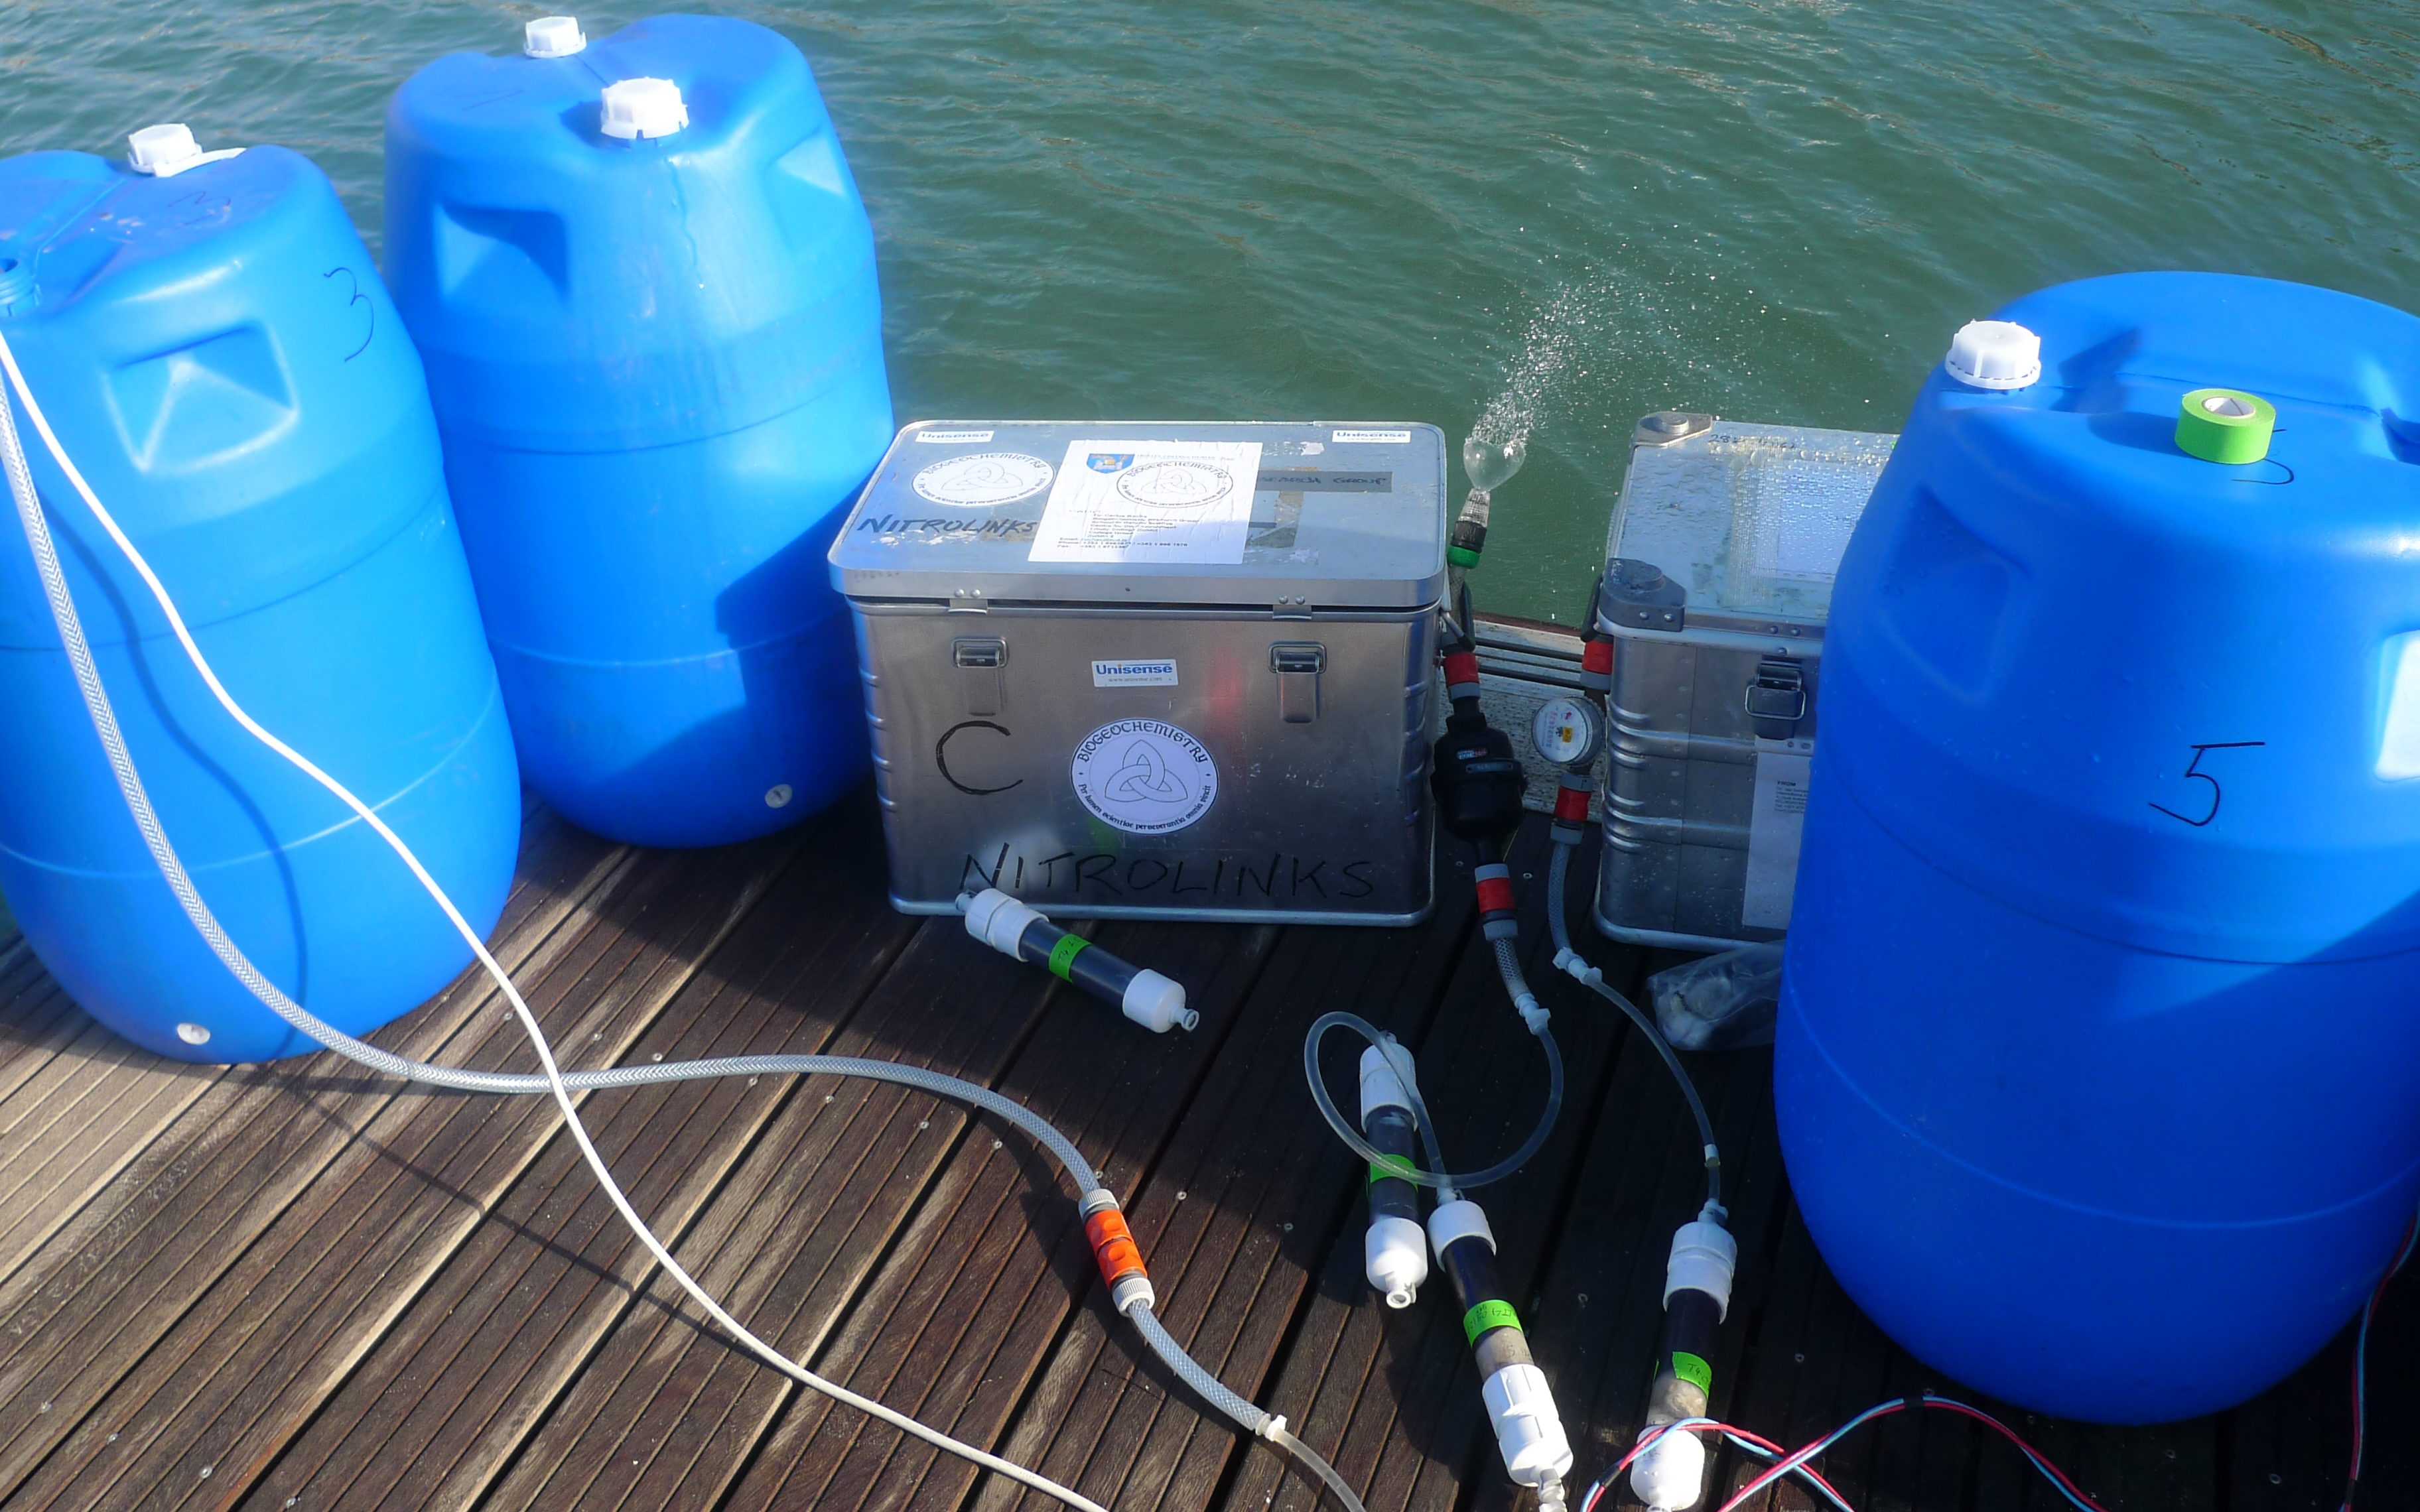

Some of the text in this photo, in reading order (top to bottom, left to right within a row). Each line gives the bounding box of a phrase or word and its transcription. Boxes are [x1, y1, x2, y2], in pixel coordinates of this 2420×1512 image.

[323, 267, 373, 362] 3
[856, 514, 1038, 537] NITROLINKS
[1095, 663, 1174, 675] Unisense
[936, 720, 1024, 795] C
[1077, 721, 1209, 763] BIOGEOCHEMISTRY
[1078, 784, 1089, 795] Per
[2148, 741, 2265, 826] 5
[959, 842, 1375, 898] NITROLINKS
